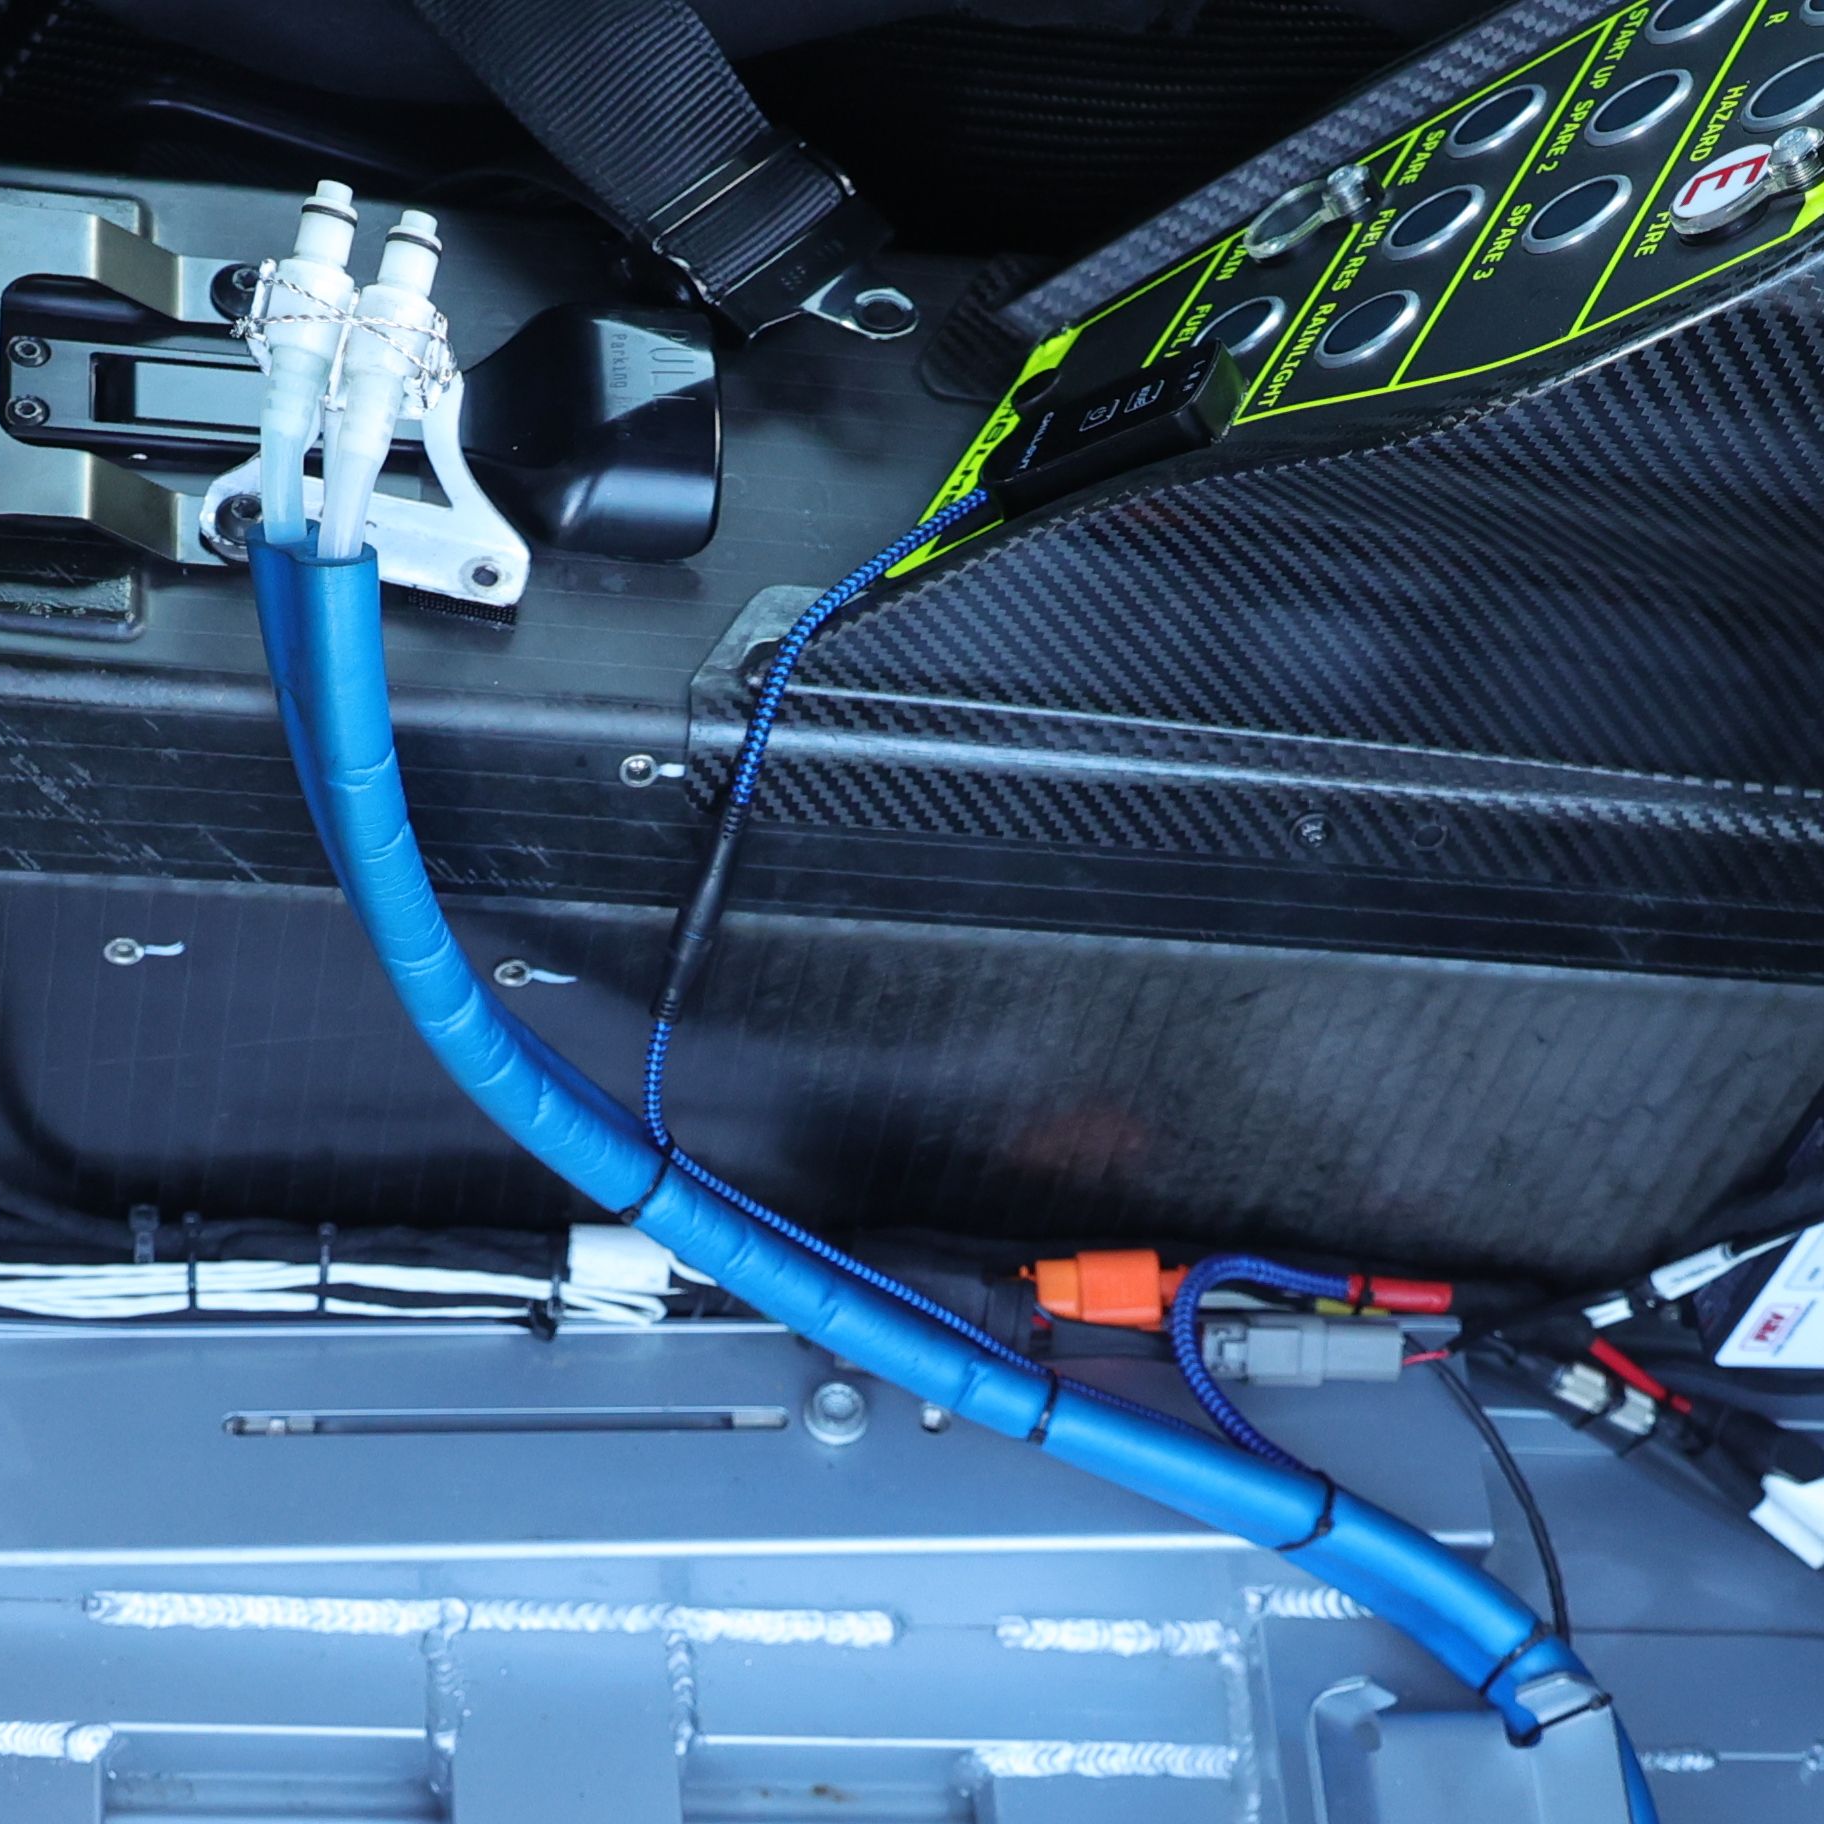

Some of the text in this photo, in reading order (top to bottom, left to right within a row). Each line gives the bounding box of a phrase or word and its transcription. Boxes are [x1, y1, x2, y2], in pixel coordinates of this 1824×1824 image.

[1588, 7, 1648, 90] START UP
[1397, 129, 1446, 186] SPARE
[1535, 99, 1594, 175] SPARE 2
[1689, 84, 1748, 163] HAZARD
[1331, 207, 1397, 292] FUEL RES
[1473, 203, 1533, 281] SPARE 3
[1633, 210, 1671, 260] FIRE
[1176, 303, 1213, 346] FUEL
[1256, 301, 1338, 408] RAINLIGHT
